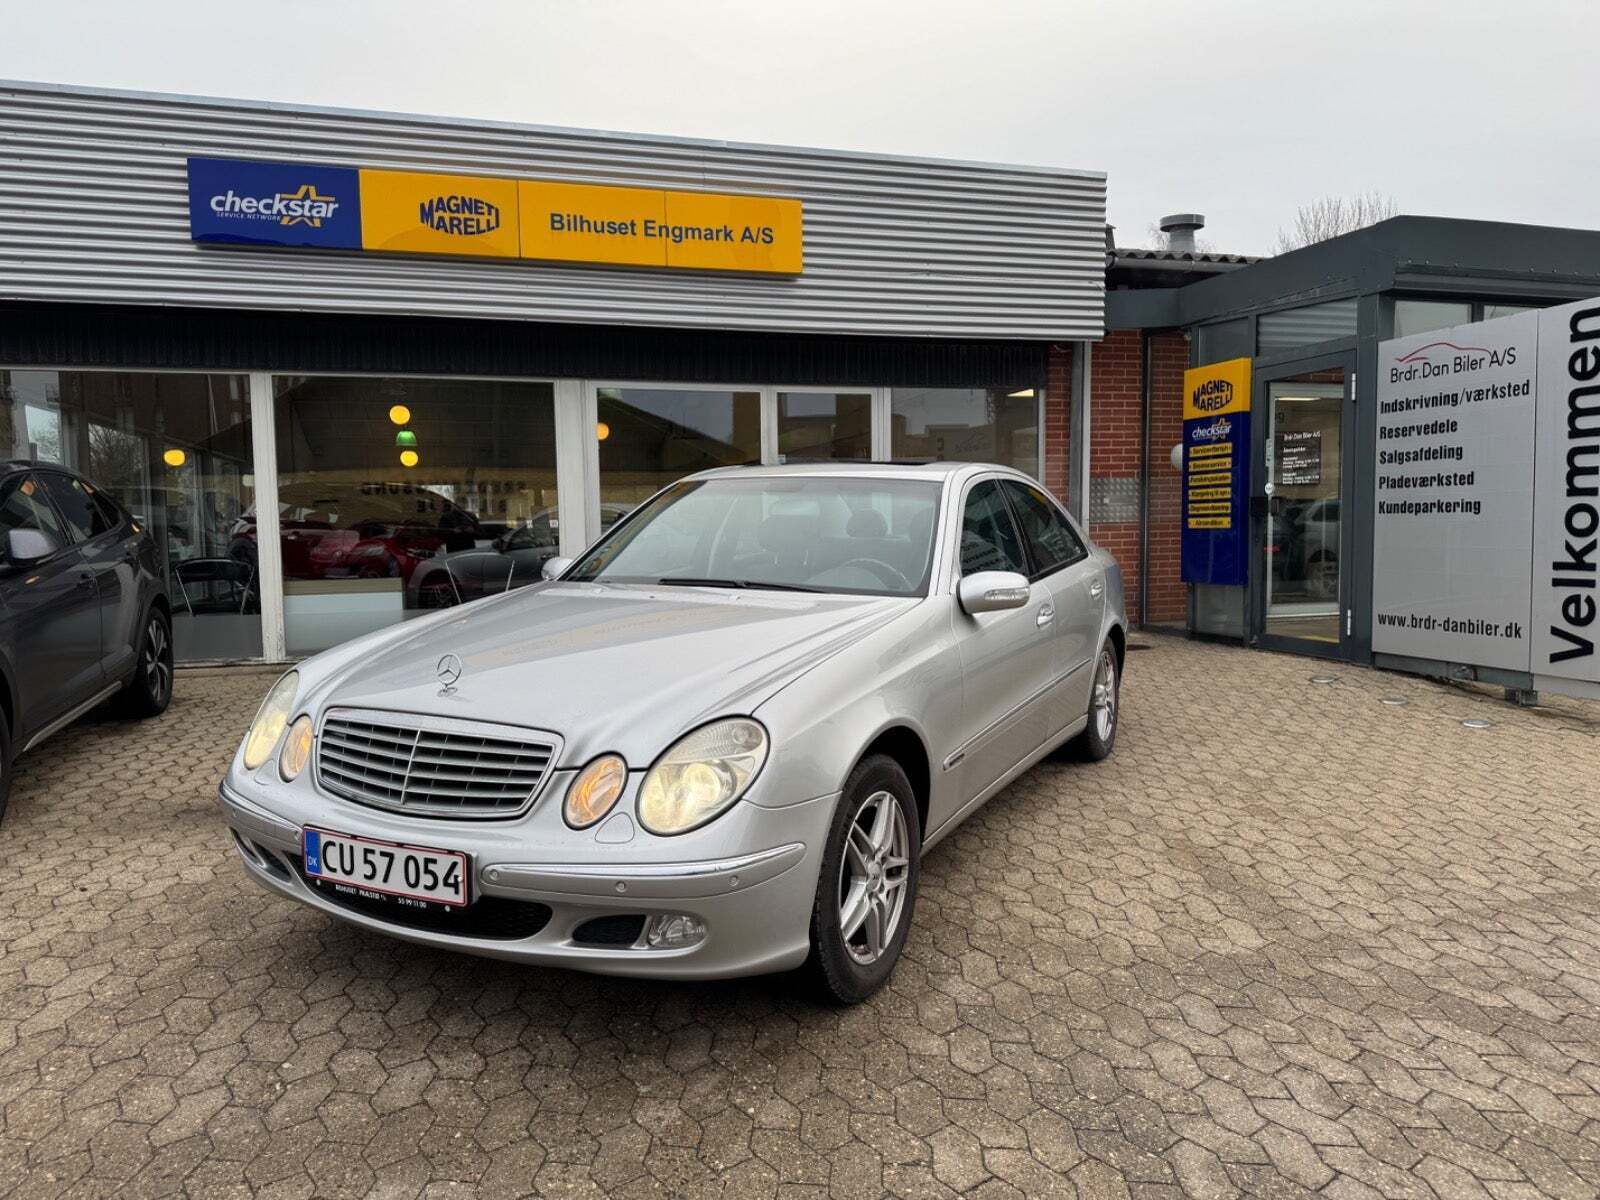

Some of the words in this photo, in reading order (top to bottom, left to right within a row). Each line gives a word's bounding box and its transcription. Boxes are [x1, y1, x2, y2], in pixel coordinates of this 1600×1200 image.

[210, 190, 339, 218] checkstar
[216, 211, 244, 219] SERVICE
[420, 195, 499, 218] MAGNETI
[420, 211, 499, 236] MARELLI
[550, 213, 637, 237] Bilhuset
[643, 219, 734, 244] Engmark
[740, 226, 774, 245] A/S
[1453, 355, 1485, 373] Biler
[1489, 346, 1517, 368] A/S
[1193, 380, 1233, 399] MAGNETI
[1380, 379, 1530, 414] Indskrivning/værksted
[1379, 418, 1458, 440] Reservedele
[1379, 444, 1463, 466] Salgsafdeling
[1378, 471, 1475, 490] Pladeværksted
[1549, 306, 1600, 664] Velkommen
[1378, 499, 1481, 516] Kundeparkering
[1377, 613, 1522, 639] www.brdr-danbiler.dk
[307, 856, 318, 867] DK
[322, 840, 355, 876] CU
[363, 848, 395, 884] 57
[403, 854, 460, 895] 054
